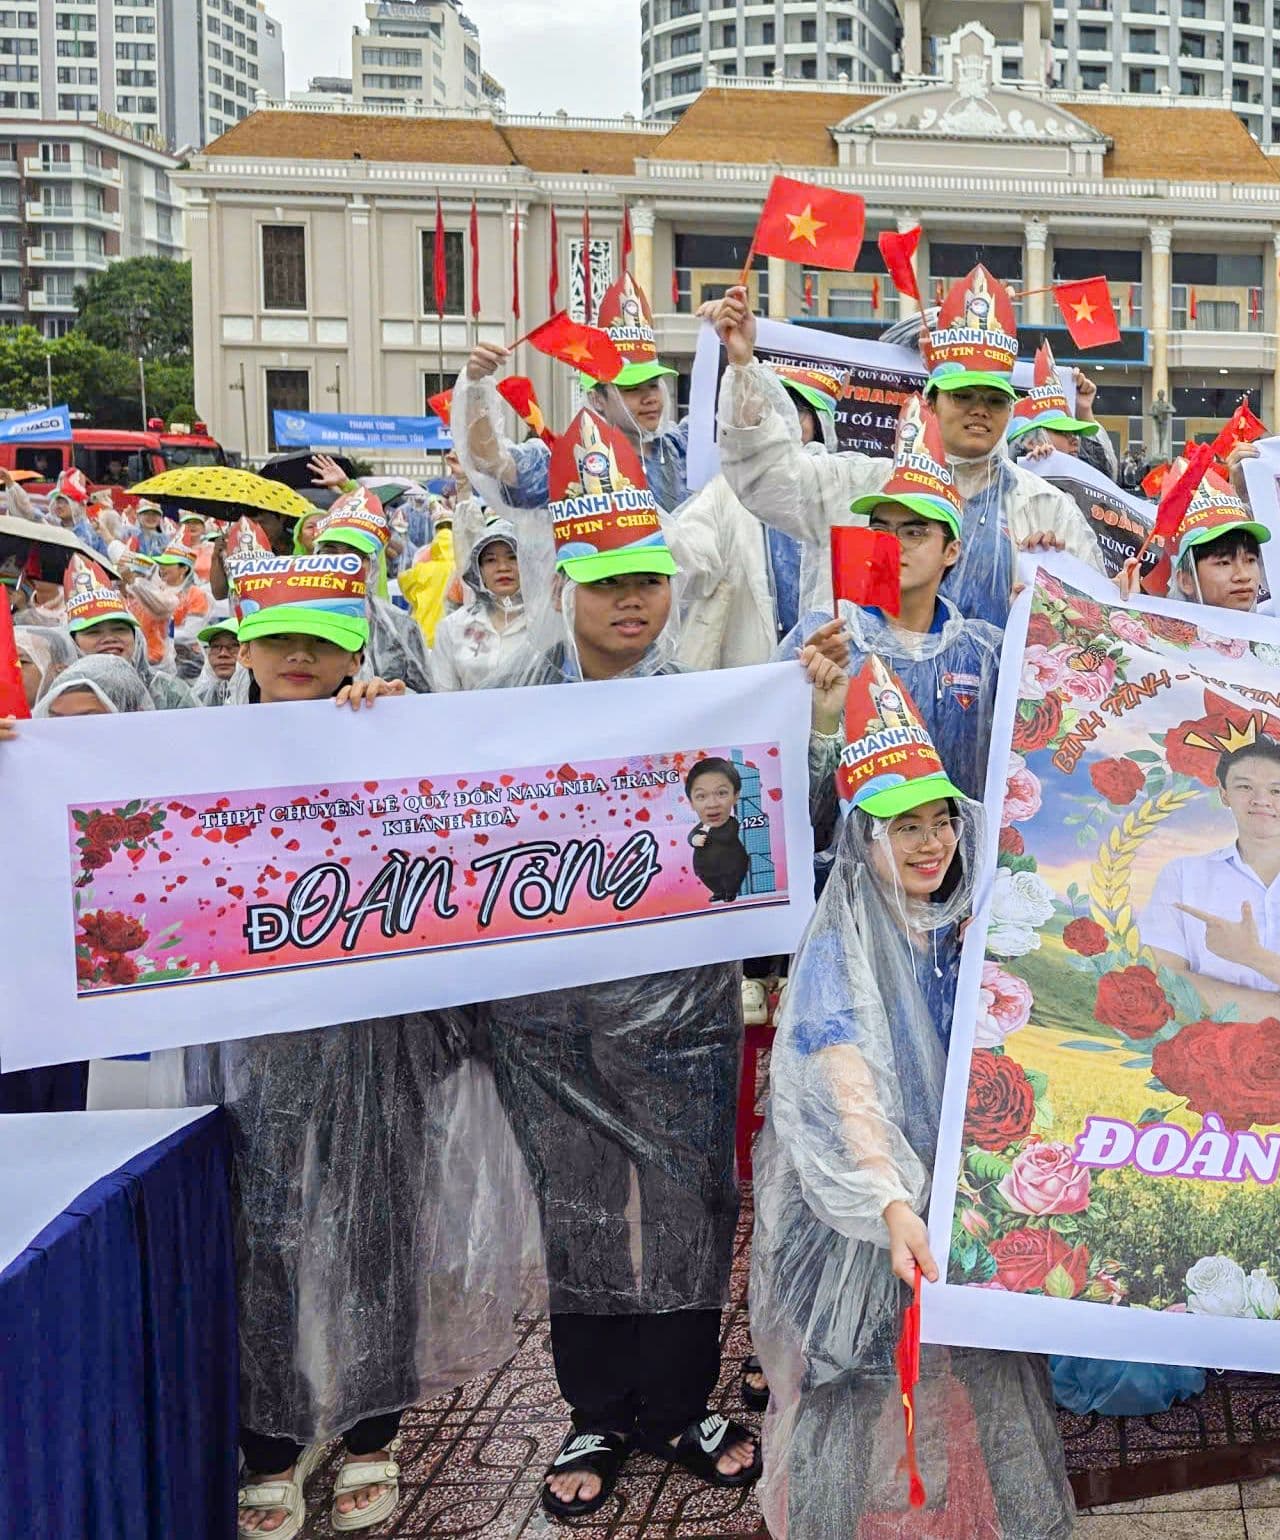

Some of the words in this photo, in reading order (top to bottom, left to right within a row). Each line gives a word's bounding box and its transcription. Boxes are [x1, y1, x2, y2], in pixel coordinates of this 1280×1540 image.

[931, 330, 983, 345] THANH
[985, 329, 1018, 353] TÙNG
[935, 347, 949, 360] TỰ
[951, 346, 974, 357] TIN
[851, 411, 873, 427] CỐ
[903, 471, 945, 493] CHIẾN
[910, 454, 951, 484] TÙNG
[574, 519, 604, 535] TIN
[1098, 532, 1136, 558] TÙNG
[244, 577, 274, 592] TIN
[287, 573, 348, 591] CHIẾN
[1052, 709, 1107, 775] BÌNH
[1101, 669, 1172, 719] TĨNH
[842, 726, 909, 765] THANH
[853, 759, 875, 777] TỰ
[878, 750, 907, 768] TIN
[200, 807, 264, 829] THPT
[270, 799, 364, 822] CHUYÊN
[371, 795, 400, 815] LÊ
[404, 790, 450, 813] QUÝ
[454, 786, 503, 807] ĐÔN
[507, 780, 557, 802] NAM
[562, 775, 607, 797] NHA
[611, 769, 680, 791] TRANG
[383, 812, 465, 837] KHÁNH
[471, 805, 518, 828] HOÀ
[244, 849, 458, 954] ĐOÀN
[568, 1434, 605, 1451] NIKE
